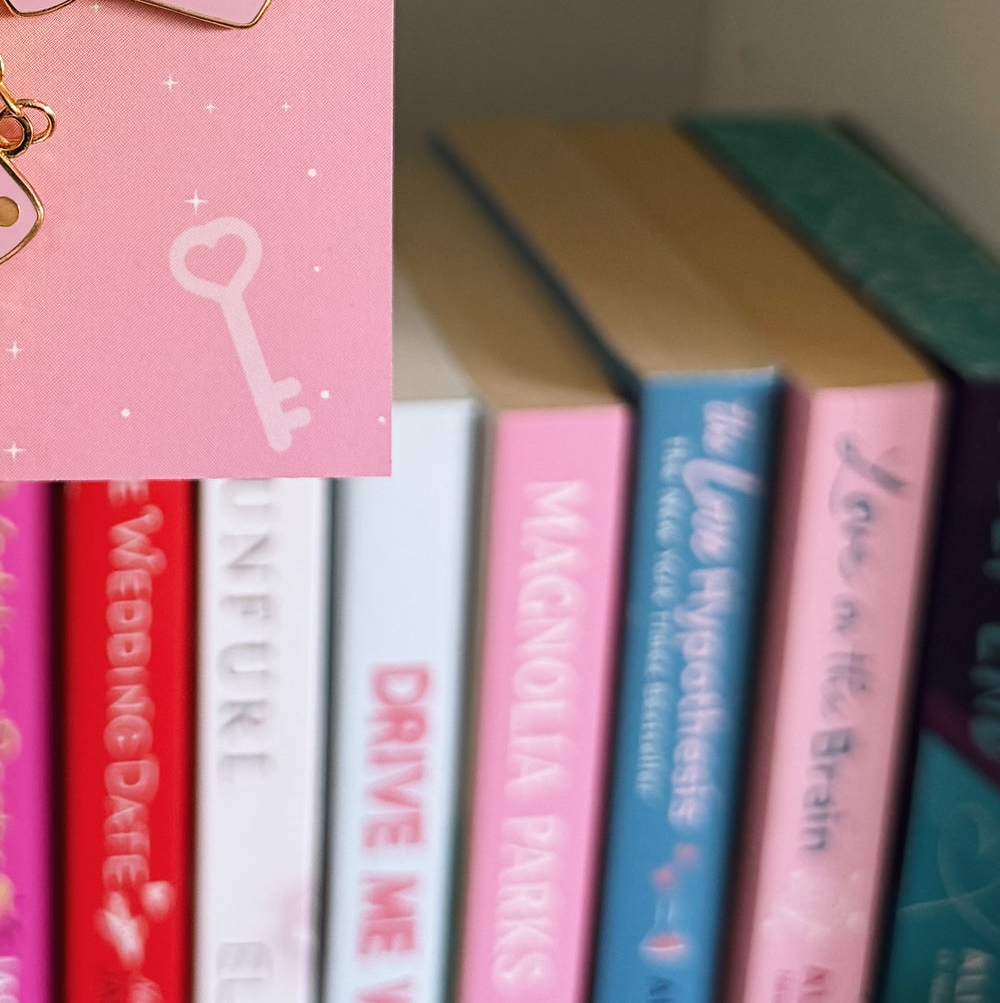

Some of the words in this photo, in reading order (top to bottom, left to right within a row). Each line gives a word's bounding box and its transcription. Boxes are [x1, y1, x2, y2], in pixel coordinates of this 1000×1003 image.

[104, 504, 167, 759] WEDDING
[506, 476, 592, 801] MAGNOLIA
[669, 565, 740, 830] Hypothesis
[103, 754, 160, 886] DATE
[362, 660, 434, 853] DRIVE
[801, 724, 862, 854] Brain
[356, 873, 421, 959] ME
[491, 812, 569, 994] PARKS
